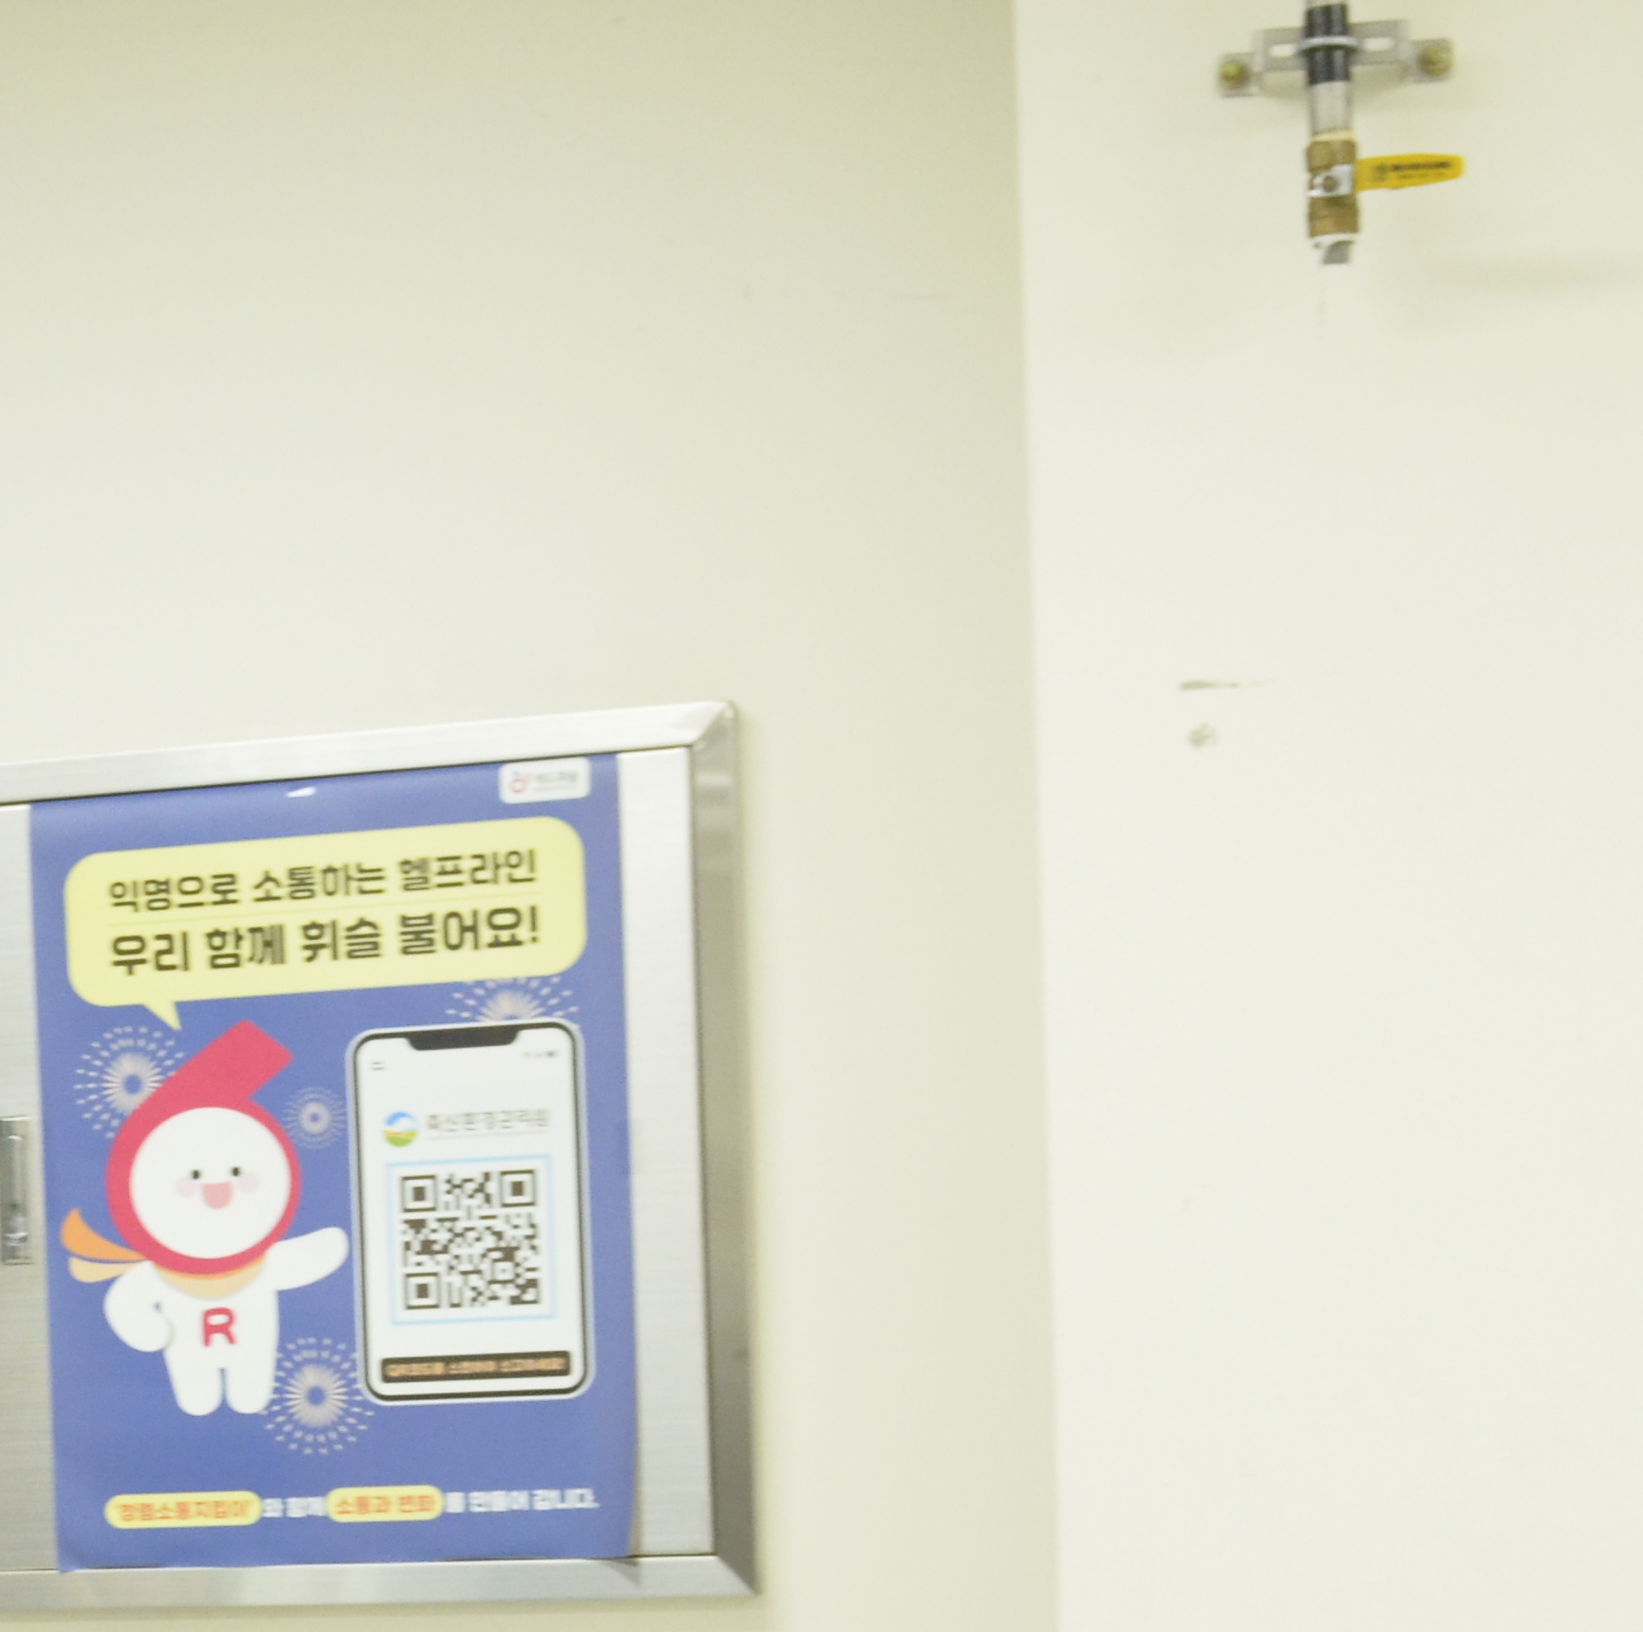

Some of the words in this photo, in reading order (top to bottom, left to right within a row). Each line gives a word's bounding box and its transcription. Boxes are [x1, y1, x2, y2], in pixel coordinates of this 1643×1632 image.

[109, 873, 240, 913] 익명으로
[253, 862, 385, 903] 소통하는
[399, 849, 537, 892] 헬프라인
[111, 930, 190, 976] 우리
[206, 923, 286, 970] 함께
[300, 916, 382, 962] 휘슬
[398, 905, 540, 956] 불어요!
[202, 1306, 237, 1348] R
